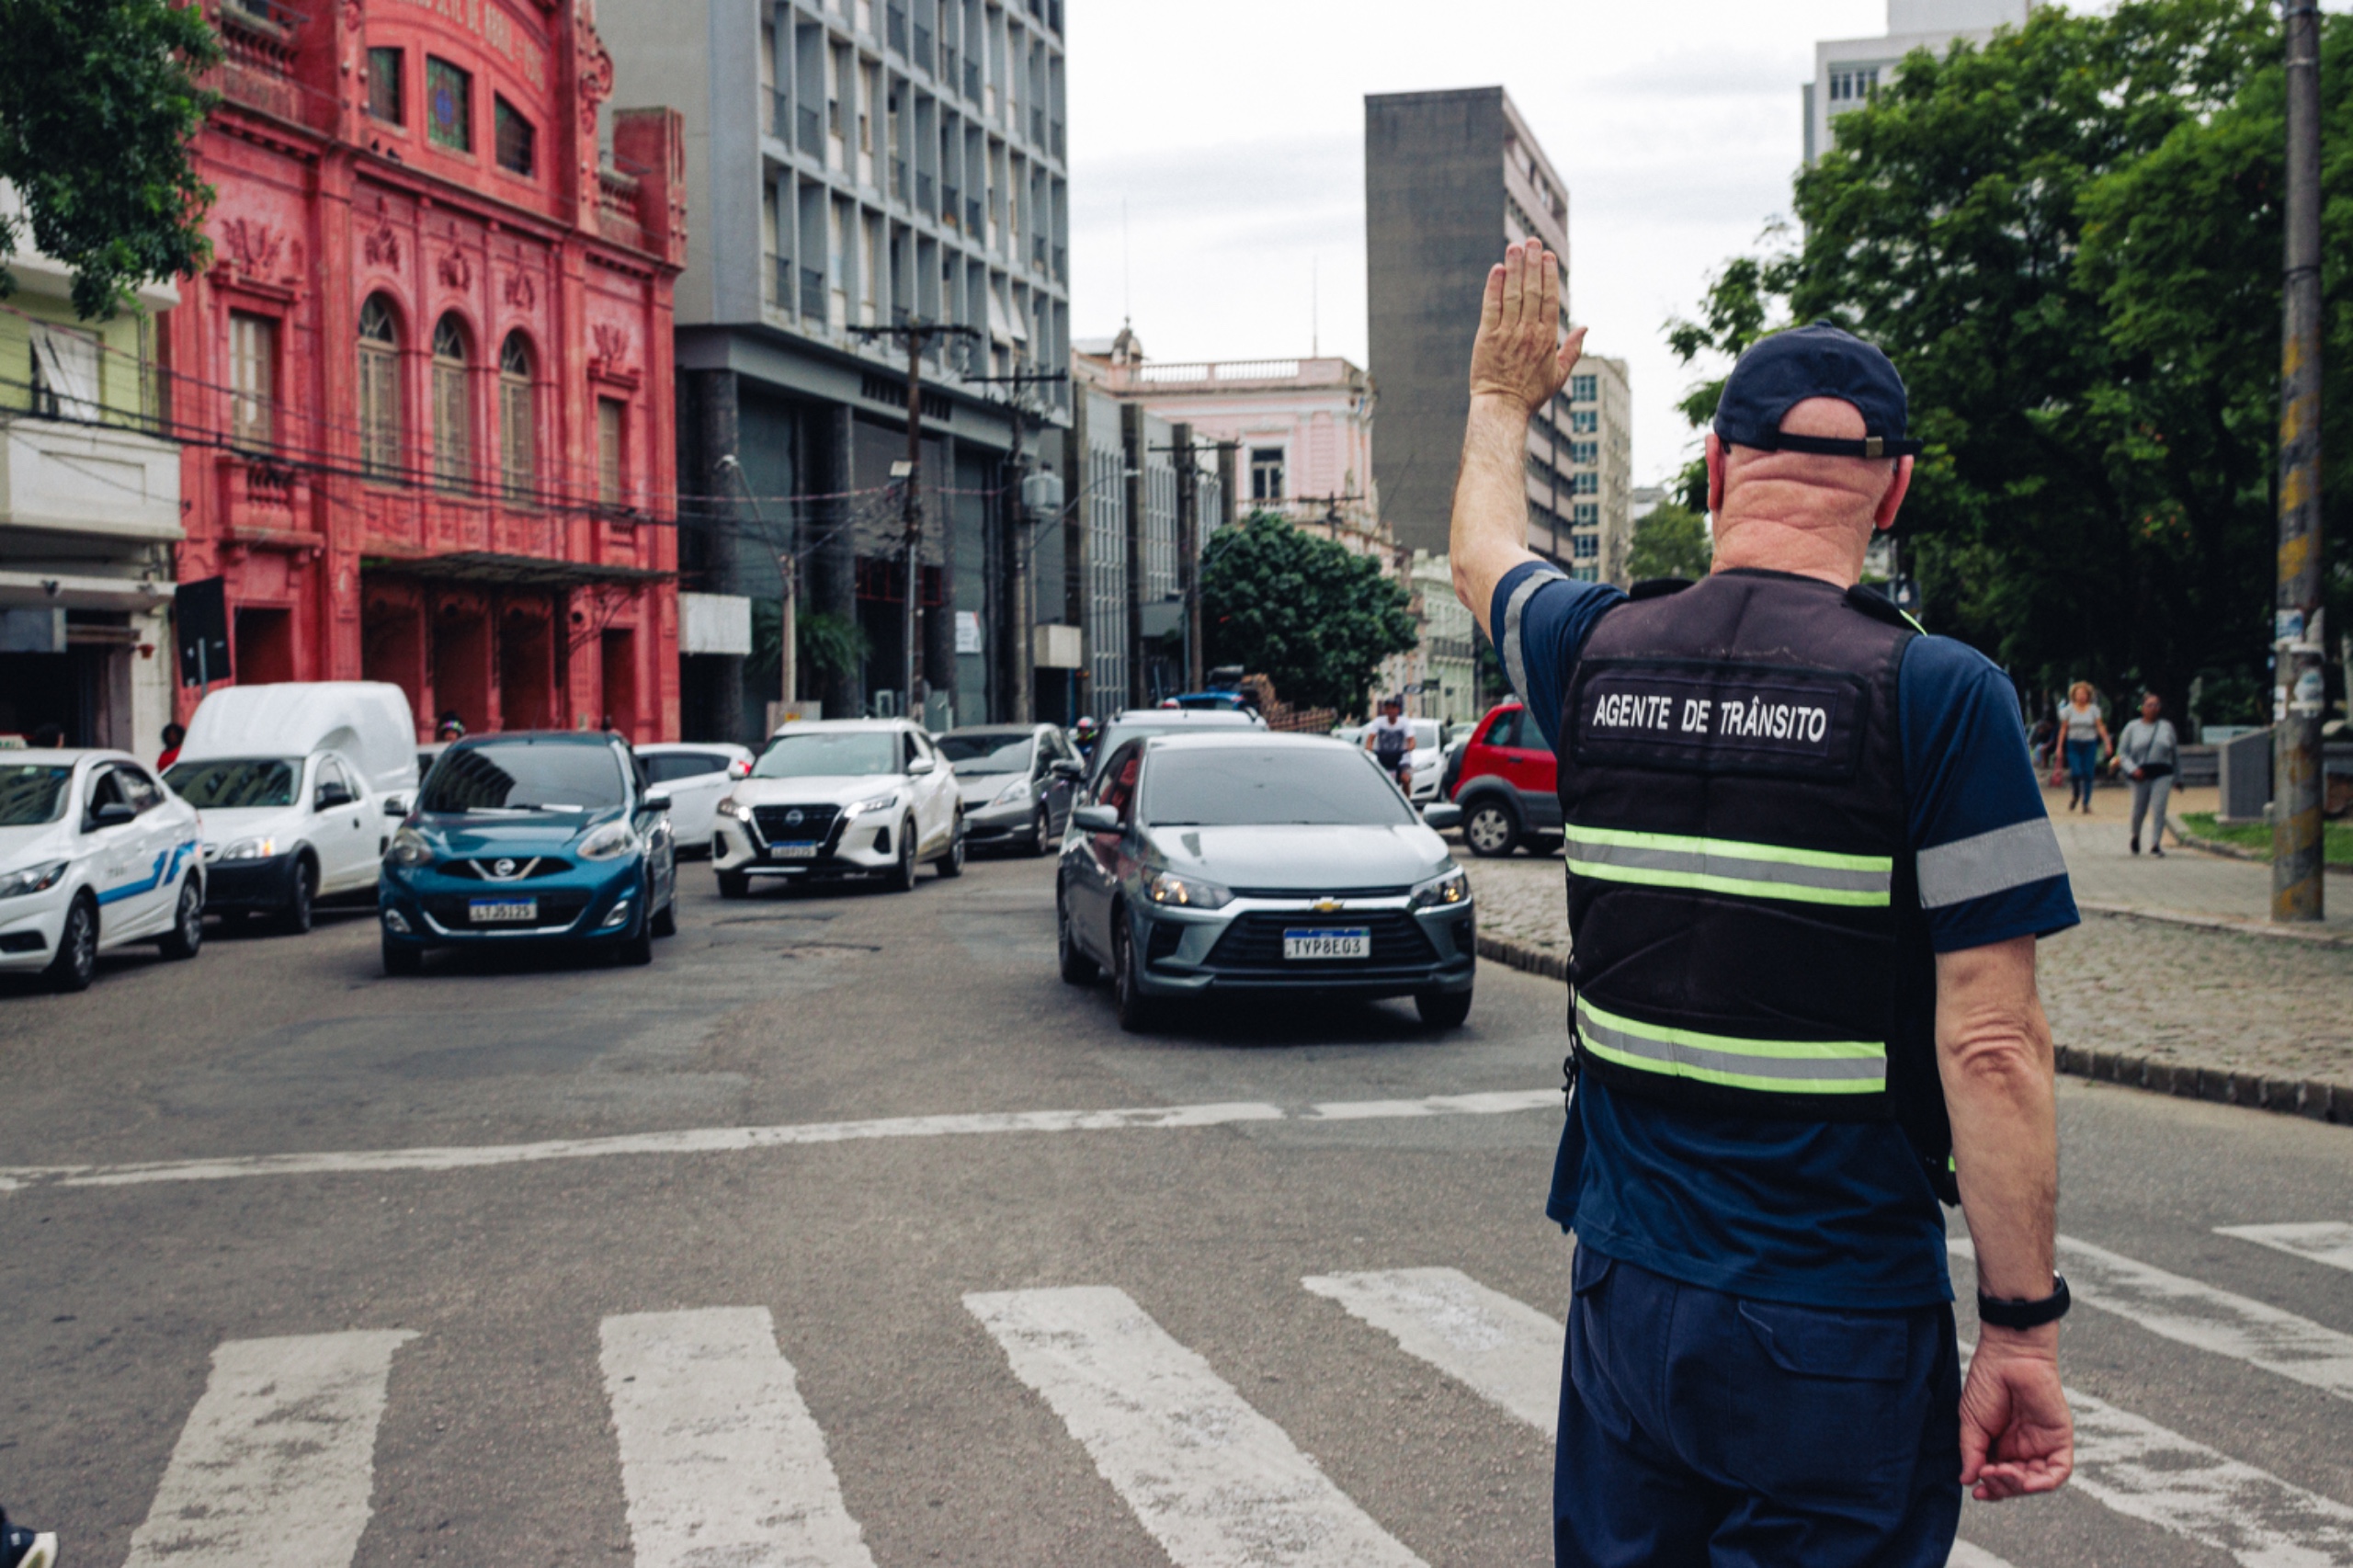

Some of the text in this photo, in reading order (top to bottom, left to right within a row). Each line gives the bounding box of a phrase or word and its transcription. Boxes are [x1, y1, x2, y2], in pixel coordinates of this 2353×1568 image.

[1593, 694, 1827, 743] AGENTE DE TRÂNSITO
